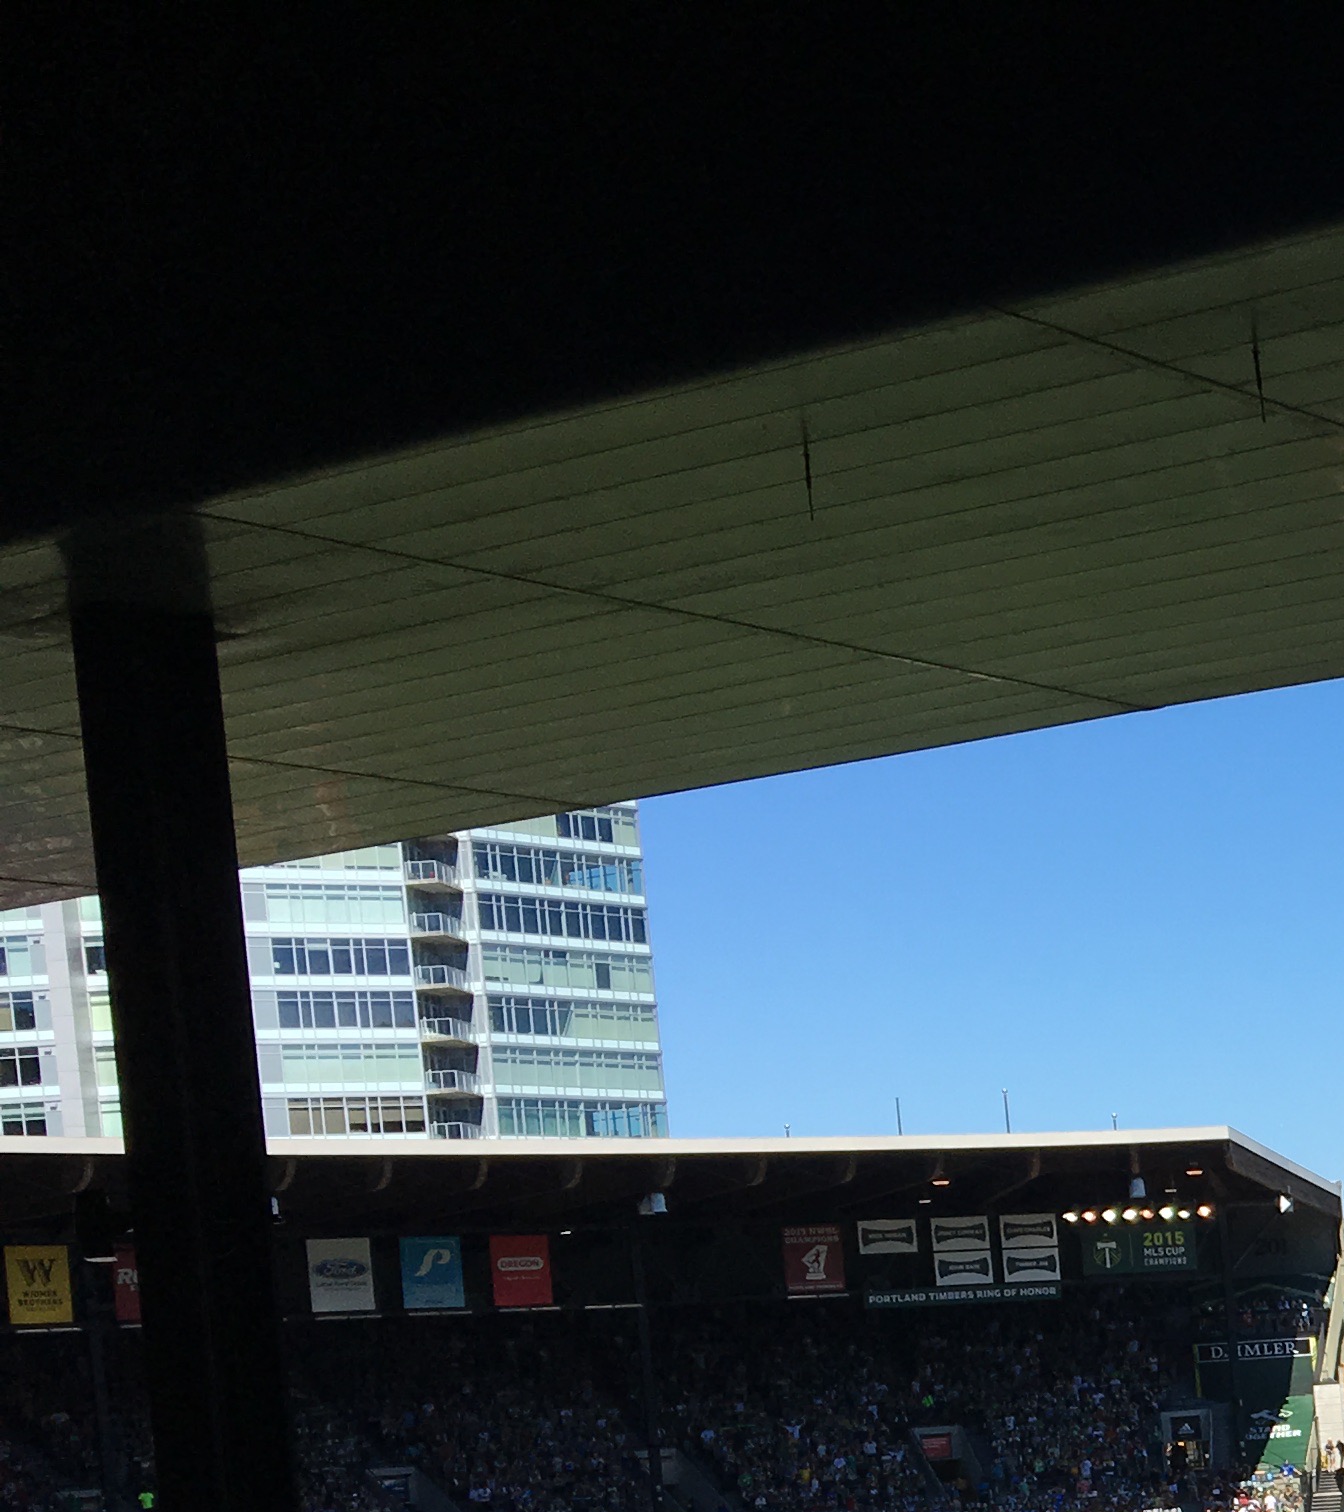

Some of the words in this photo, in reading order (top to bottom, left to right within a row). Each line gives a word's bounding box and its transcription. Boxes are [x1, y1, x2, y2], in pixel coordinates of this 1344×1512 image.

[1143, 1231, 1185, 1246] 2015
[1143, 1248, 1164, 1257] MLS
[1165, 1246, 1186, 1256] CUP
[869, 1292, 927, 1304] PORTLAND
[928, 1291, 975, 1302] TIMBERS
[976, 1288, 1001, 1299] RING
[1003, 1287, 1018, 1297] OF
[1019, 1286, 1057, 1297] HONOR
